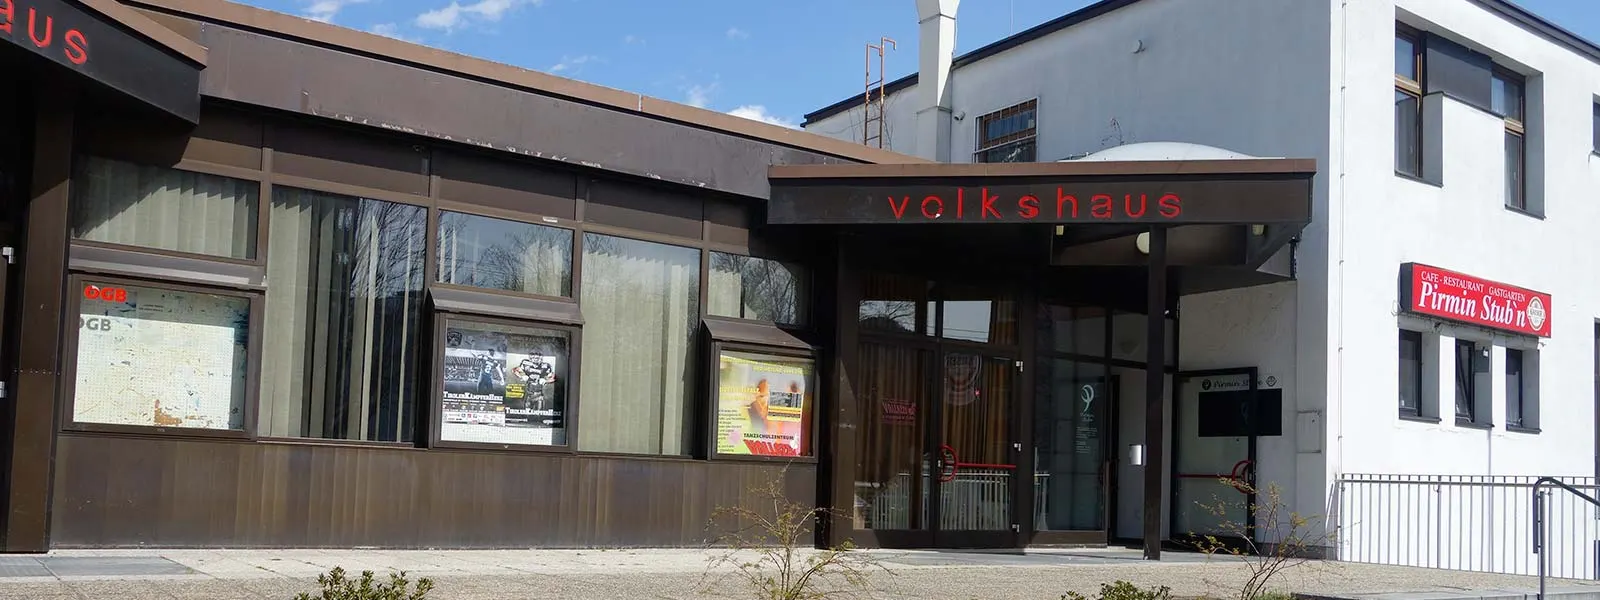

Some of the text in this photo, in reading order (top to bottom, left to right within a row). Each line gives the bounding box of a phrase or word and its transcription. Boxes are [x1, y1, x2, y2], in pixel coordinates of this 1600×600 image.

[887, 187, 1183, 220] volkshaus
[1418, 280, 1477, 318] Pirmin
[1421, 270, 1439, 282] CAFE
[1443, 275, 1484, 294] RESTAURANT
[1488, 286, 1526, 303] GASTGARTEN
